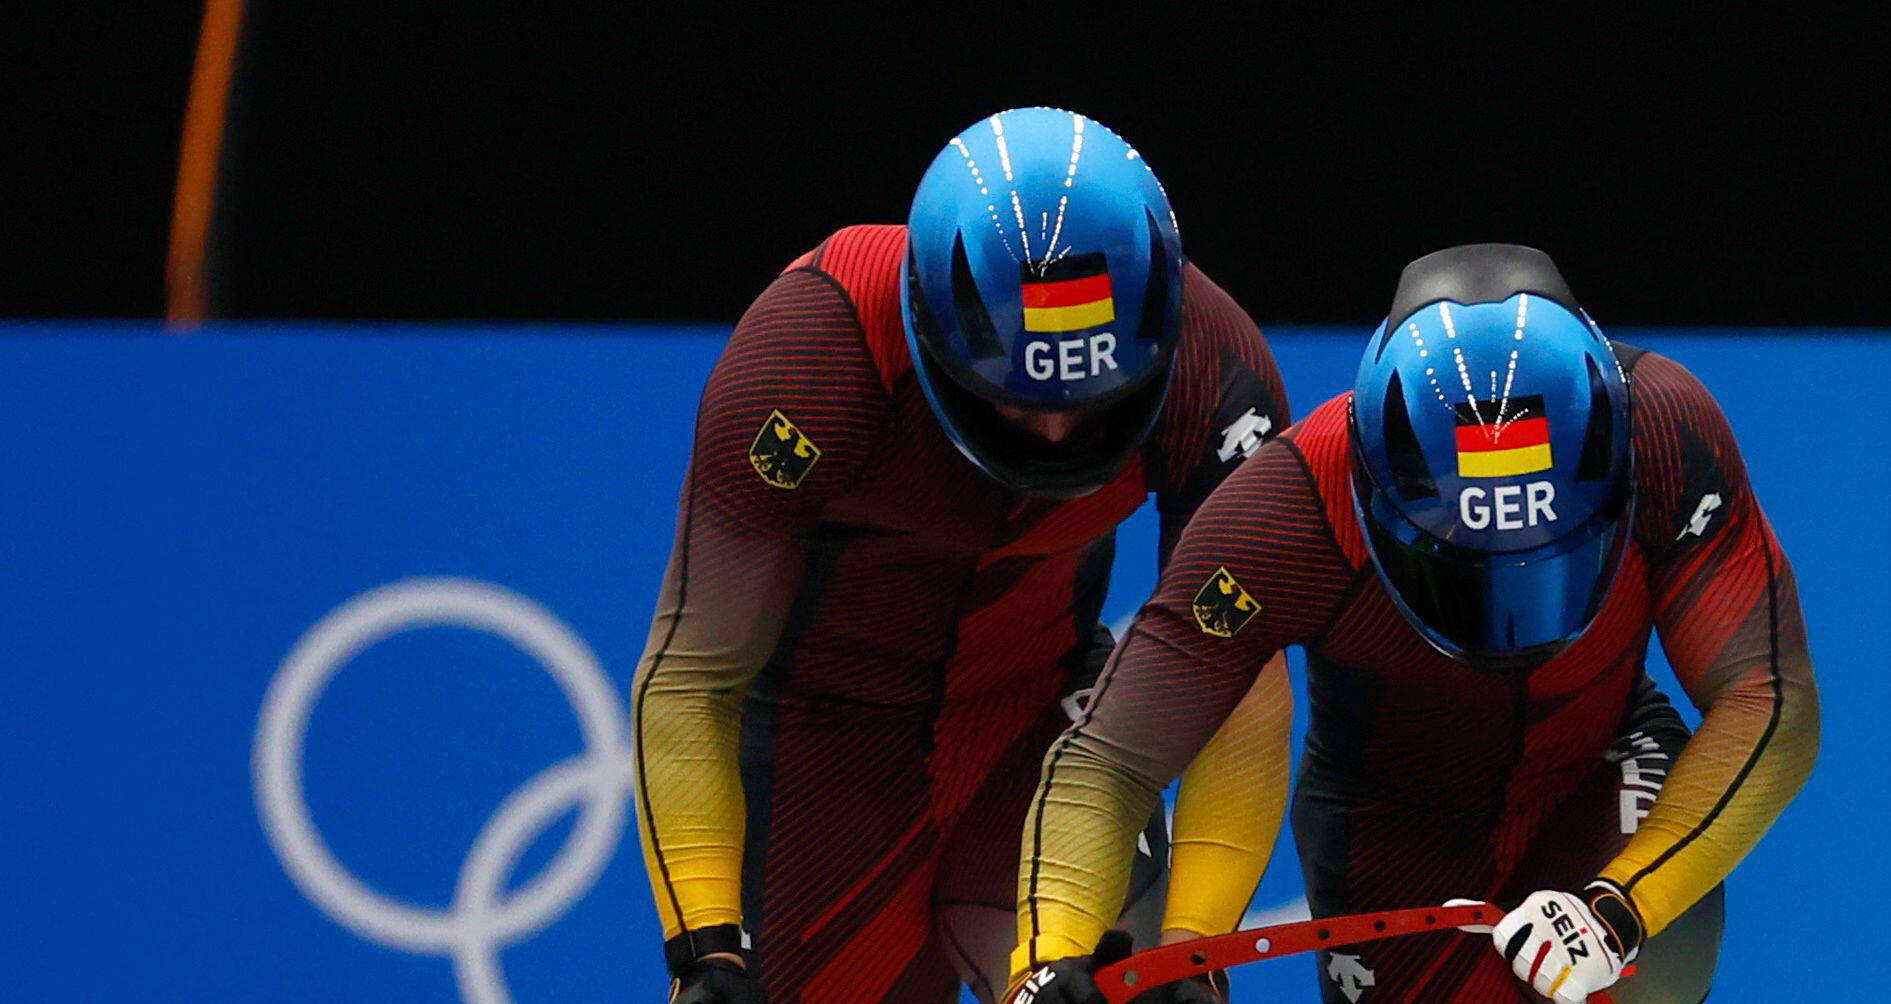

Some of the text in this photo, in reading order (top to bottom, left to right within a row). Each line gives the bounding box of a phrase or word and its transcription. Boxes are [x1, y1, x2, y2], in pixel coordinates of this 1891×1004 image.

[1025, 332, 1118, 381] GER
[1460, 481, 1558, 530] GER
[1541, 901, 1590, 966] SEIZ
